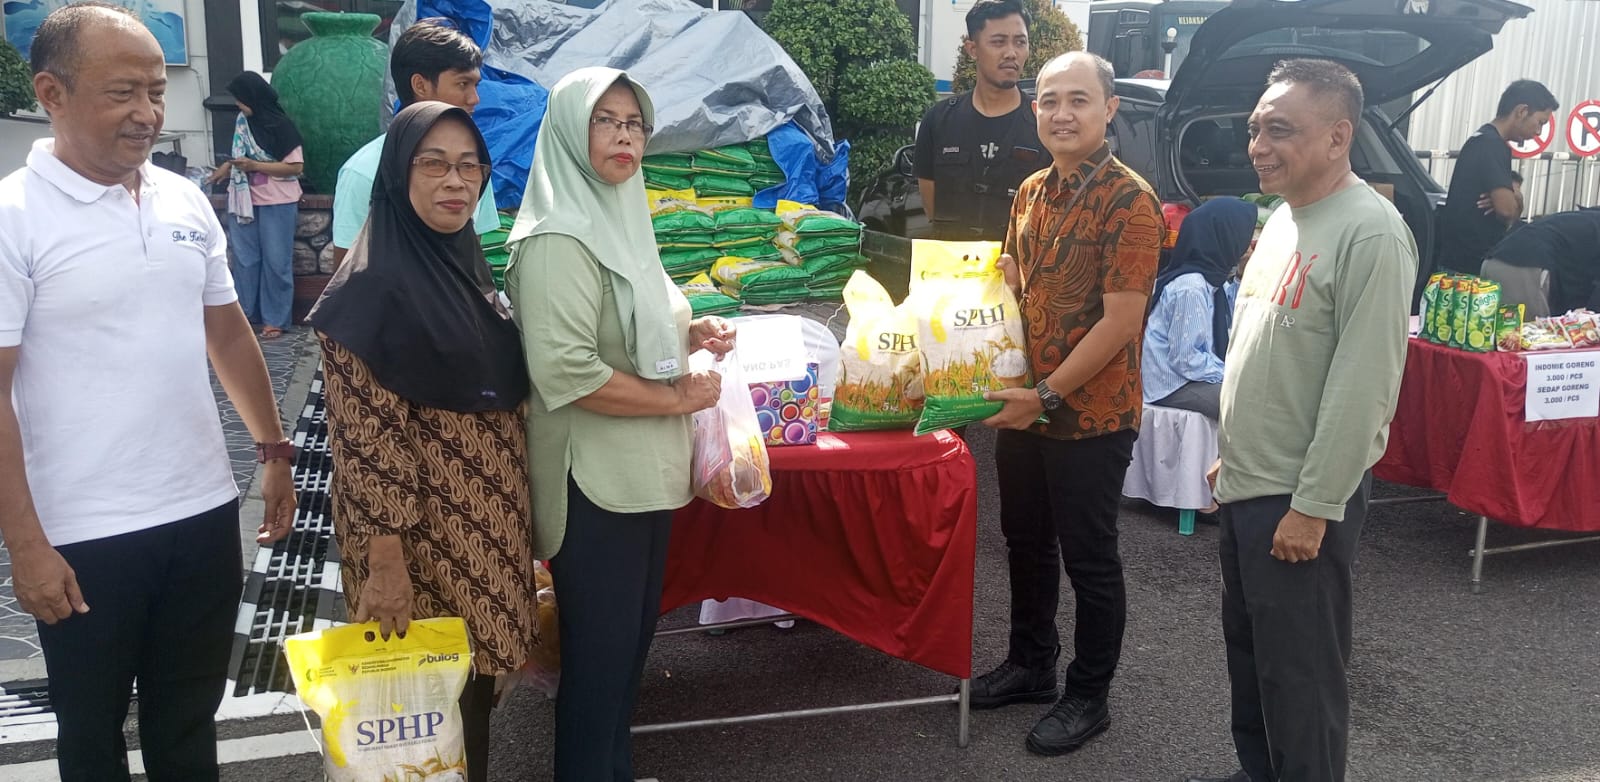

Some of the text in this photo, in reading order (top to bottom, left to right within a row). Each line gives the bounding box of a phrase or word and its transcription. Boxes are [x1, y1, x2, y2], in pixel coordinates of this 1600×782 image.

[878, 332, 917, 352] SPH
[1535, 360, 1595, 371] INDOMIE GORENG
[971, 382, 979, 393] 5
[1562, 383, 1590, 392] GORENG
[1544, 396, 1563, 404] 3.000
[1567, 394, 1580, 402] PCS
[427, 652, 459, 664] bulog
[357, 711, 444, 746] SPHP
